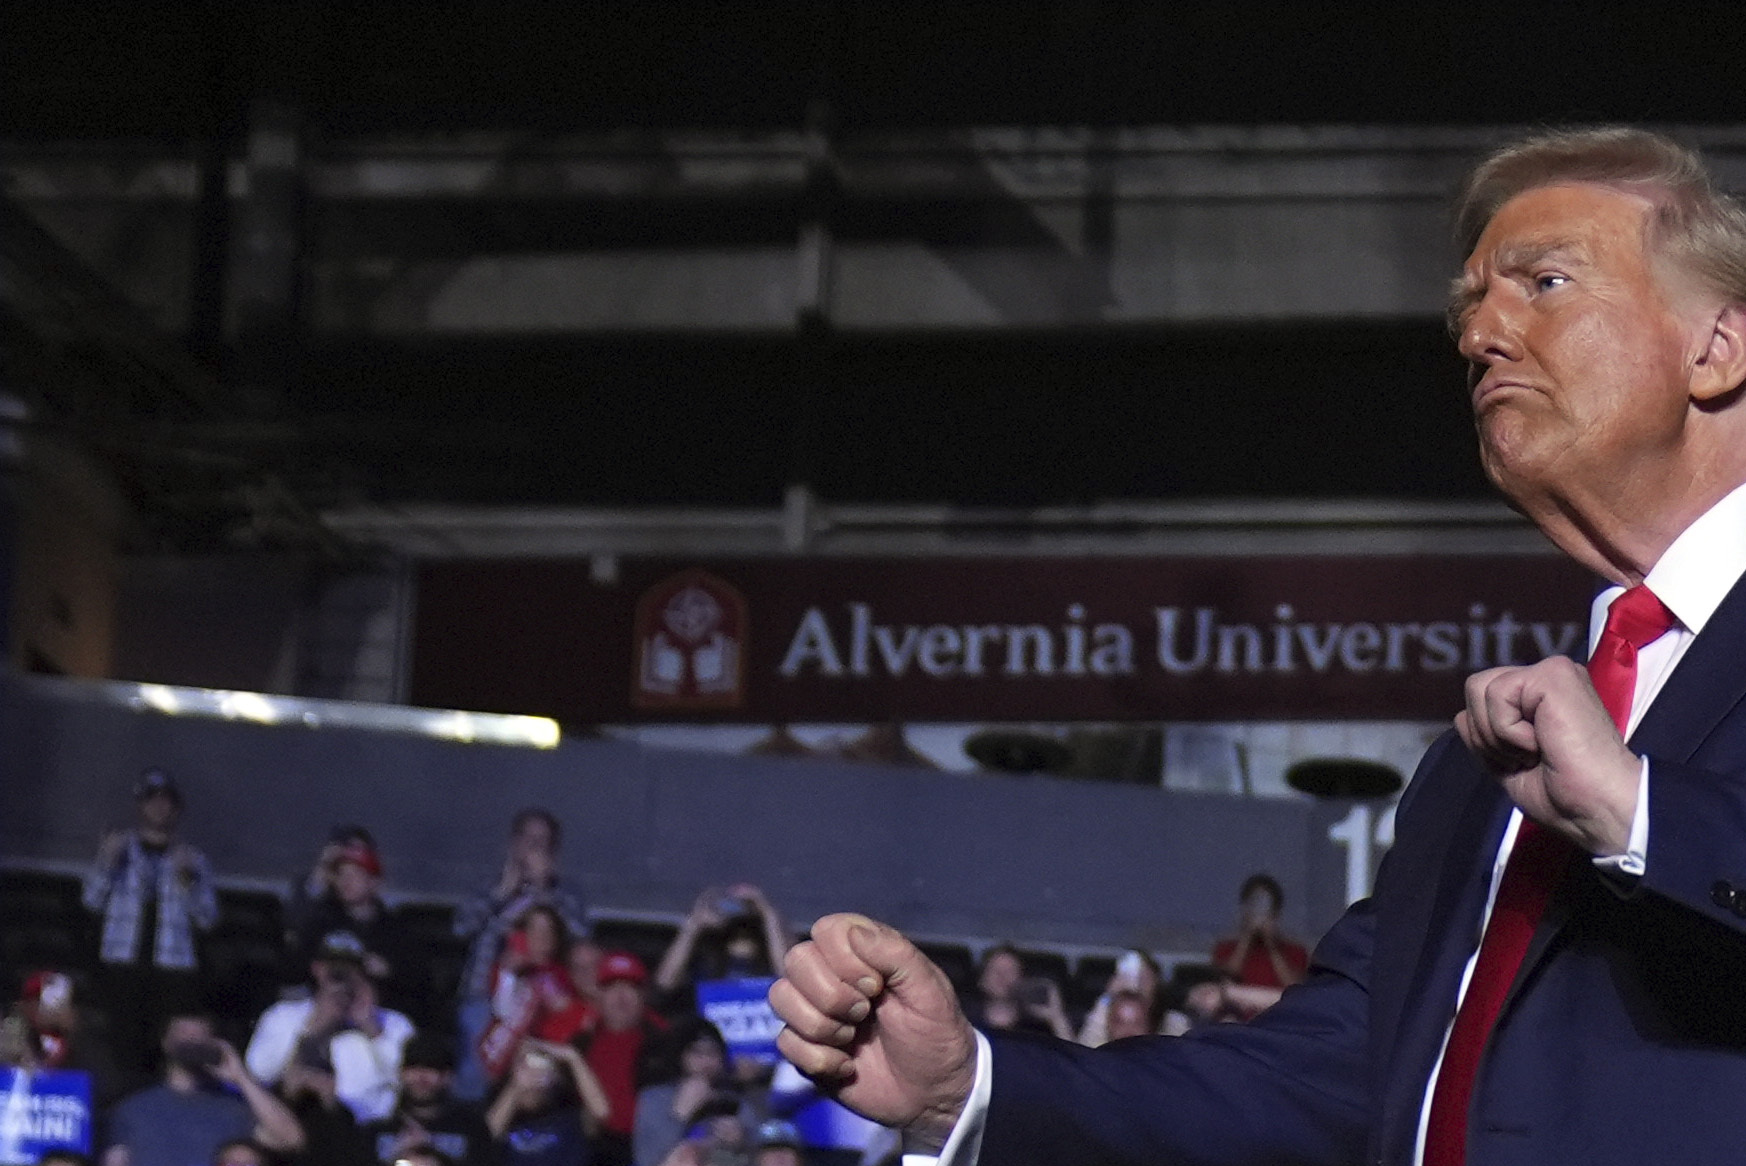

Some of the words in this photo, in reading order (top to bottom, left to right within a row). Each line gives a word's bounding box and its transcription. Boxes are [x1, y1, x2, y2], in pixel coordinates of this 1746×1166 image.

[780, 603, 1137, 677] Alvernia
[1156, 603, 1583, 675] University
[1328, 805, 1396, 906] 1
